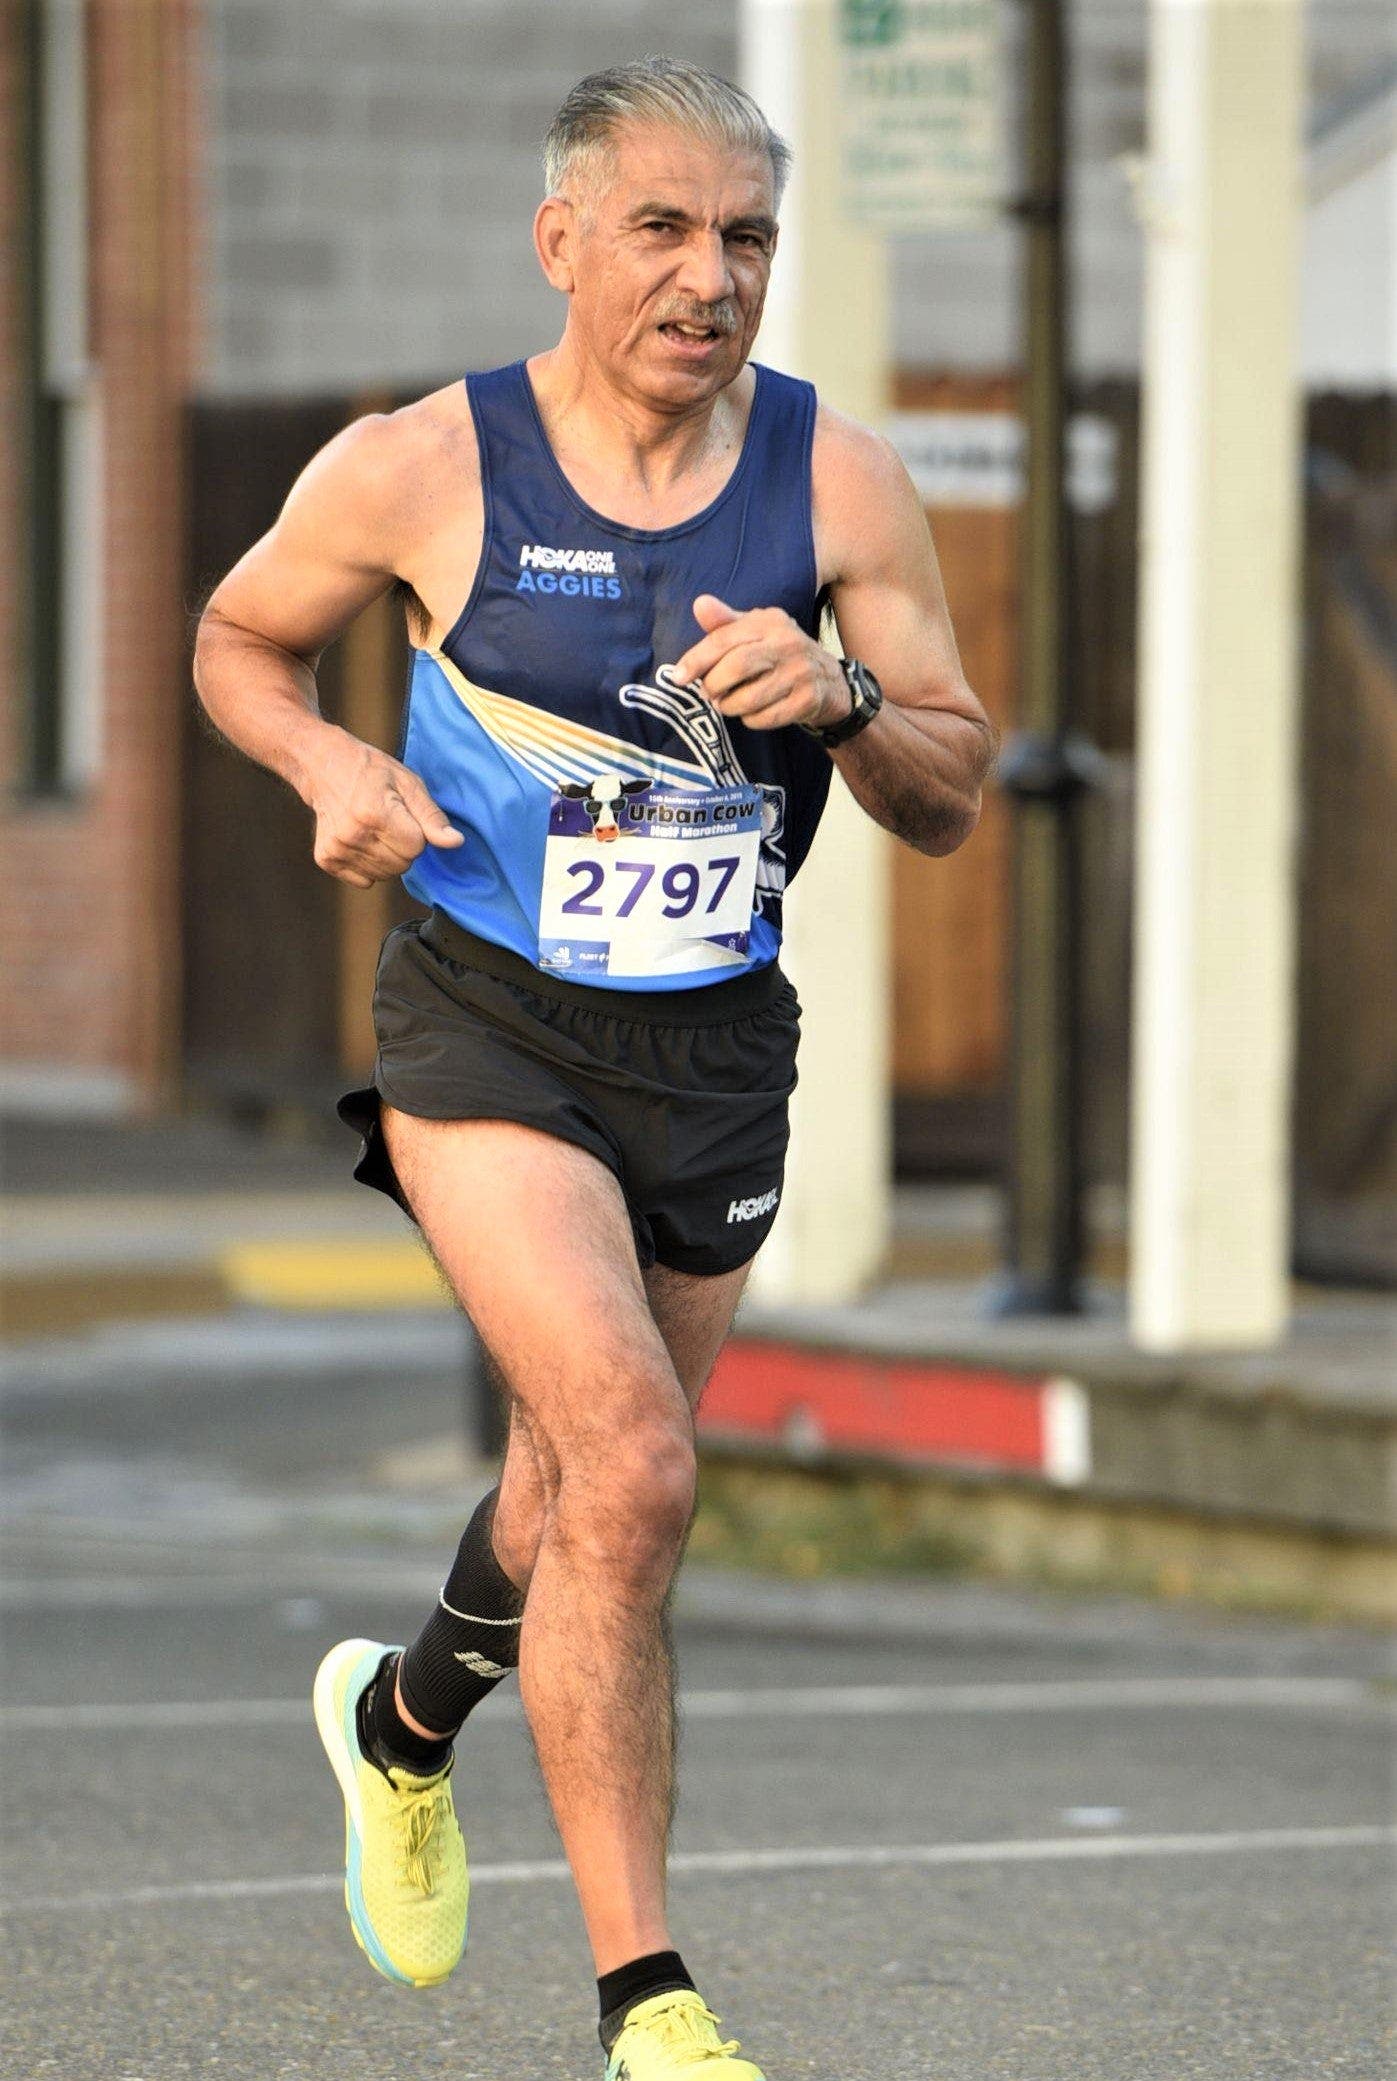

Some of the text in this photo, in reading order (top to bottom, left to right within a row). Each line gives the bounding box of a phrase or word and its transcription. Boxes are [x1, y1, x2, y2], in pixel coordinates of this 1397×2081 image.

[520, 545, 614, 572] HOKA ONE
[515, 570, 622, 599] AGGIES
[629, 803, 706, 824] Urban
[681, 823, 737, 838] Marathon
[562, 856, 740, 918] 2797
